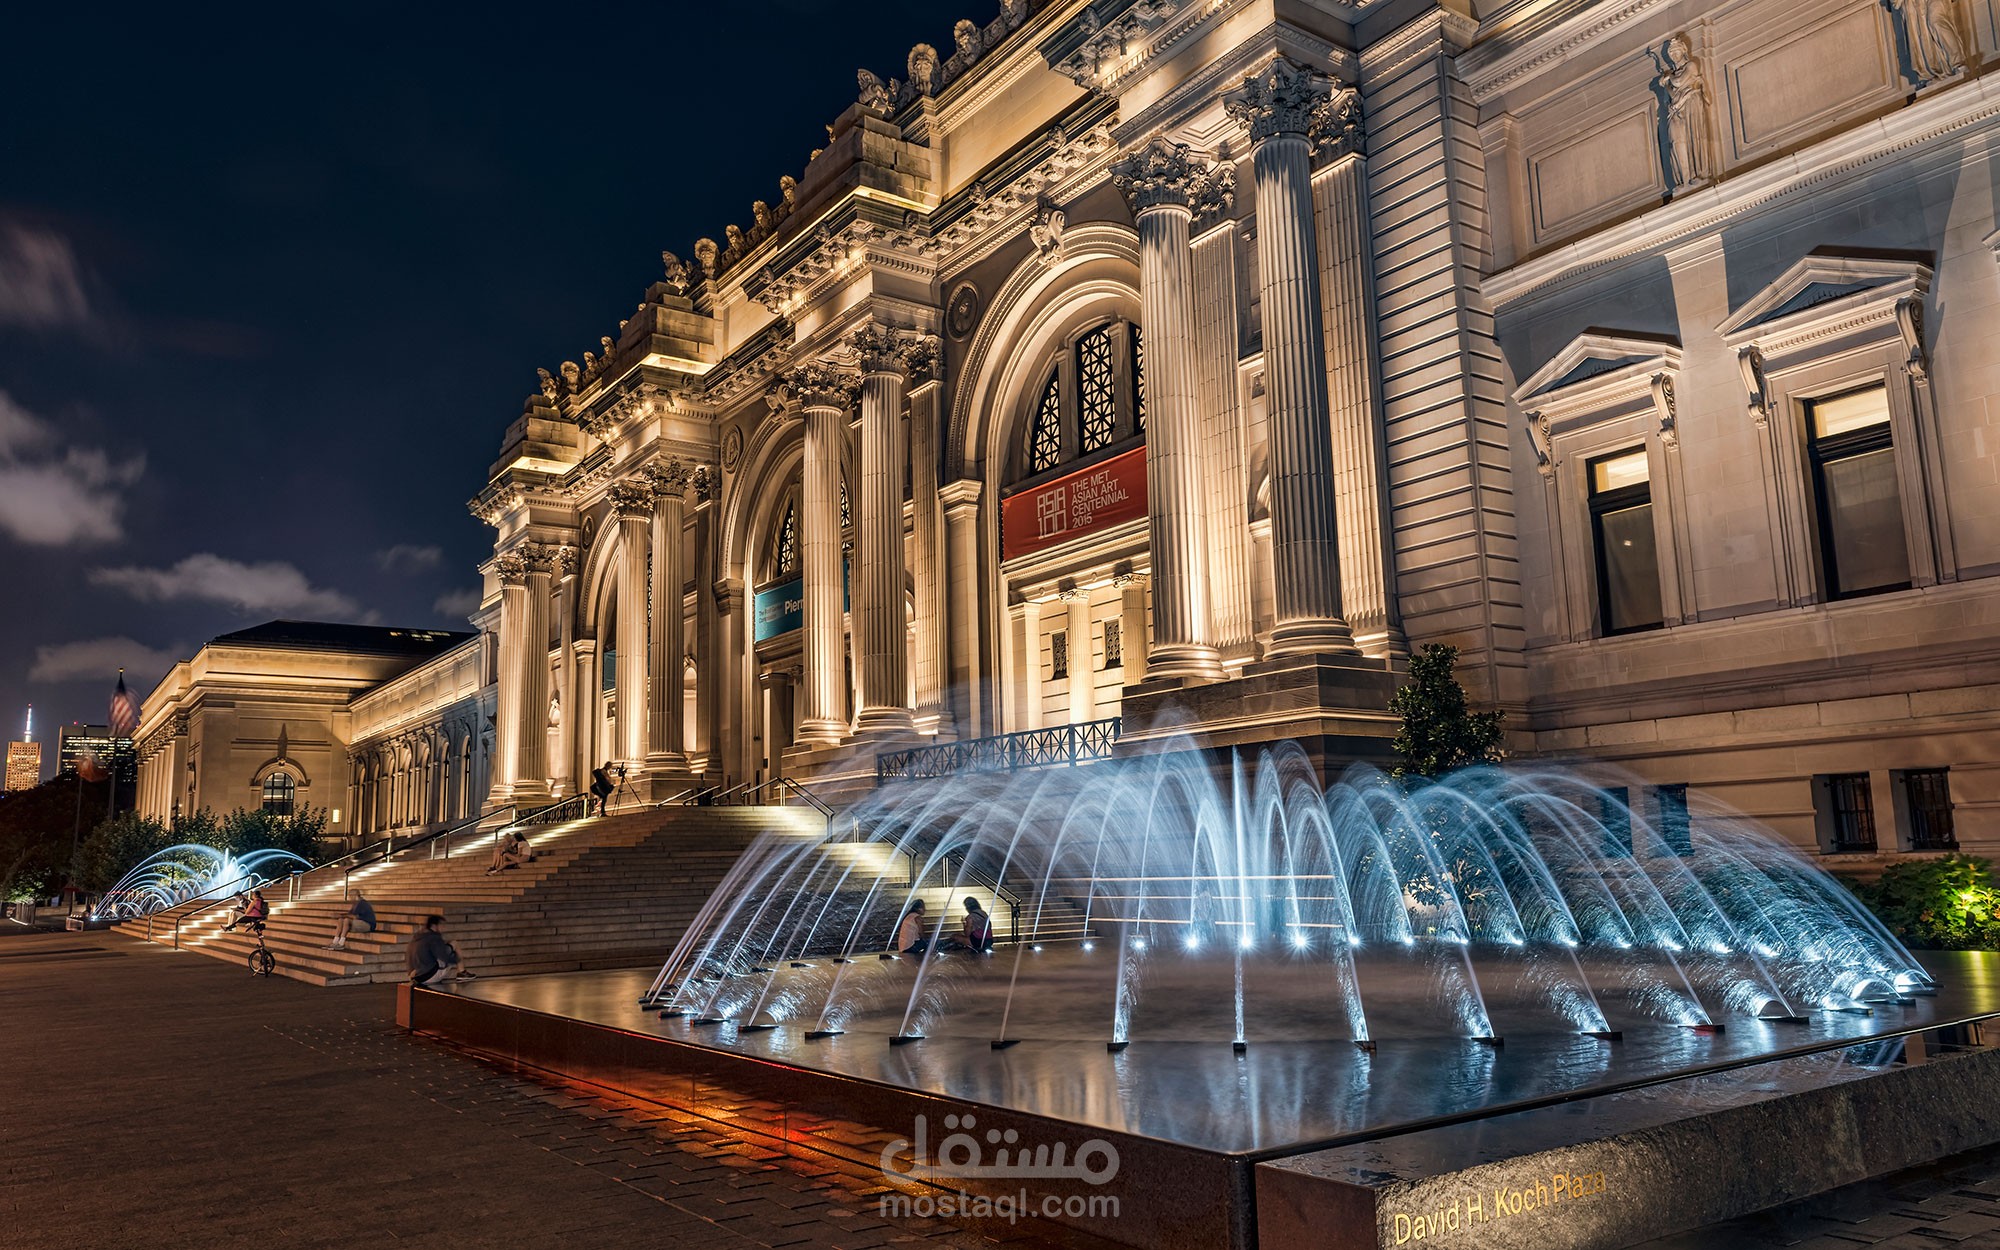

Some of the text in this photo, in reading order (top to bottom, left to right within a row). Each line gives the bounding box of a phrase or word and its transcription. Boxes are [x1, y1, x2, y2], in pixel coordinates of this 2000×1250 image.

[1071, 470, 1110, 493] THE MET
[1072, 479, 1119, 506] ASIAN ART
[1037, 486, 1066, 518] ASIA
[1072, 488, 1129, 517] CENTENNIAL
[1073, 512, 1093, 529] 2015
[1394, 1170, 1607, 1246] David H. Koch Plaza
